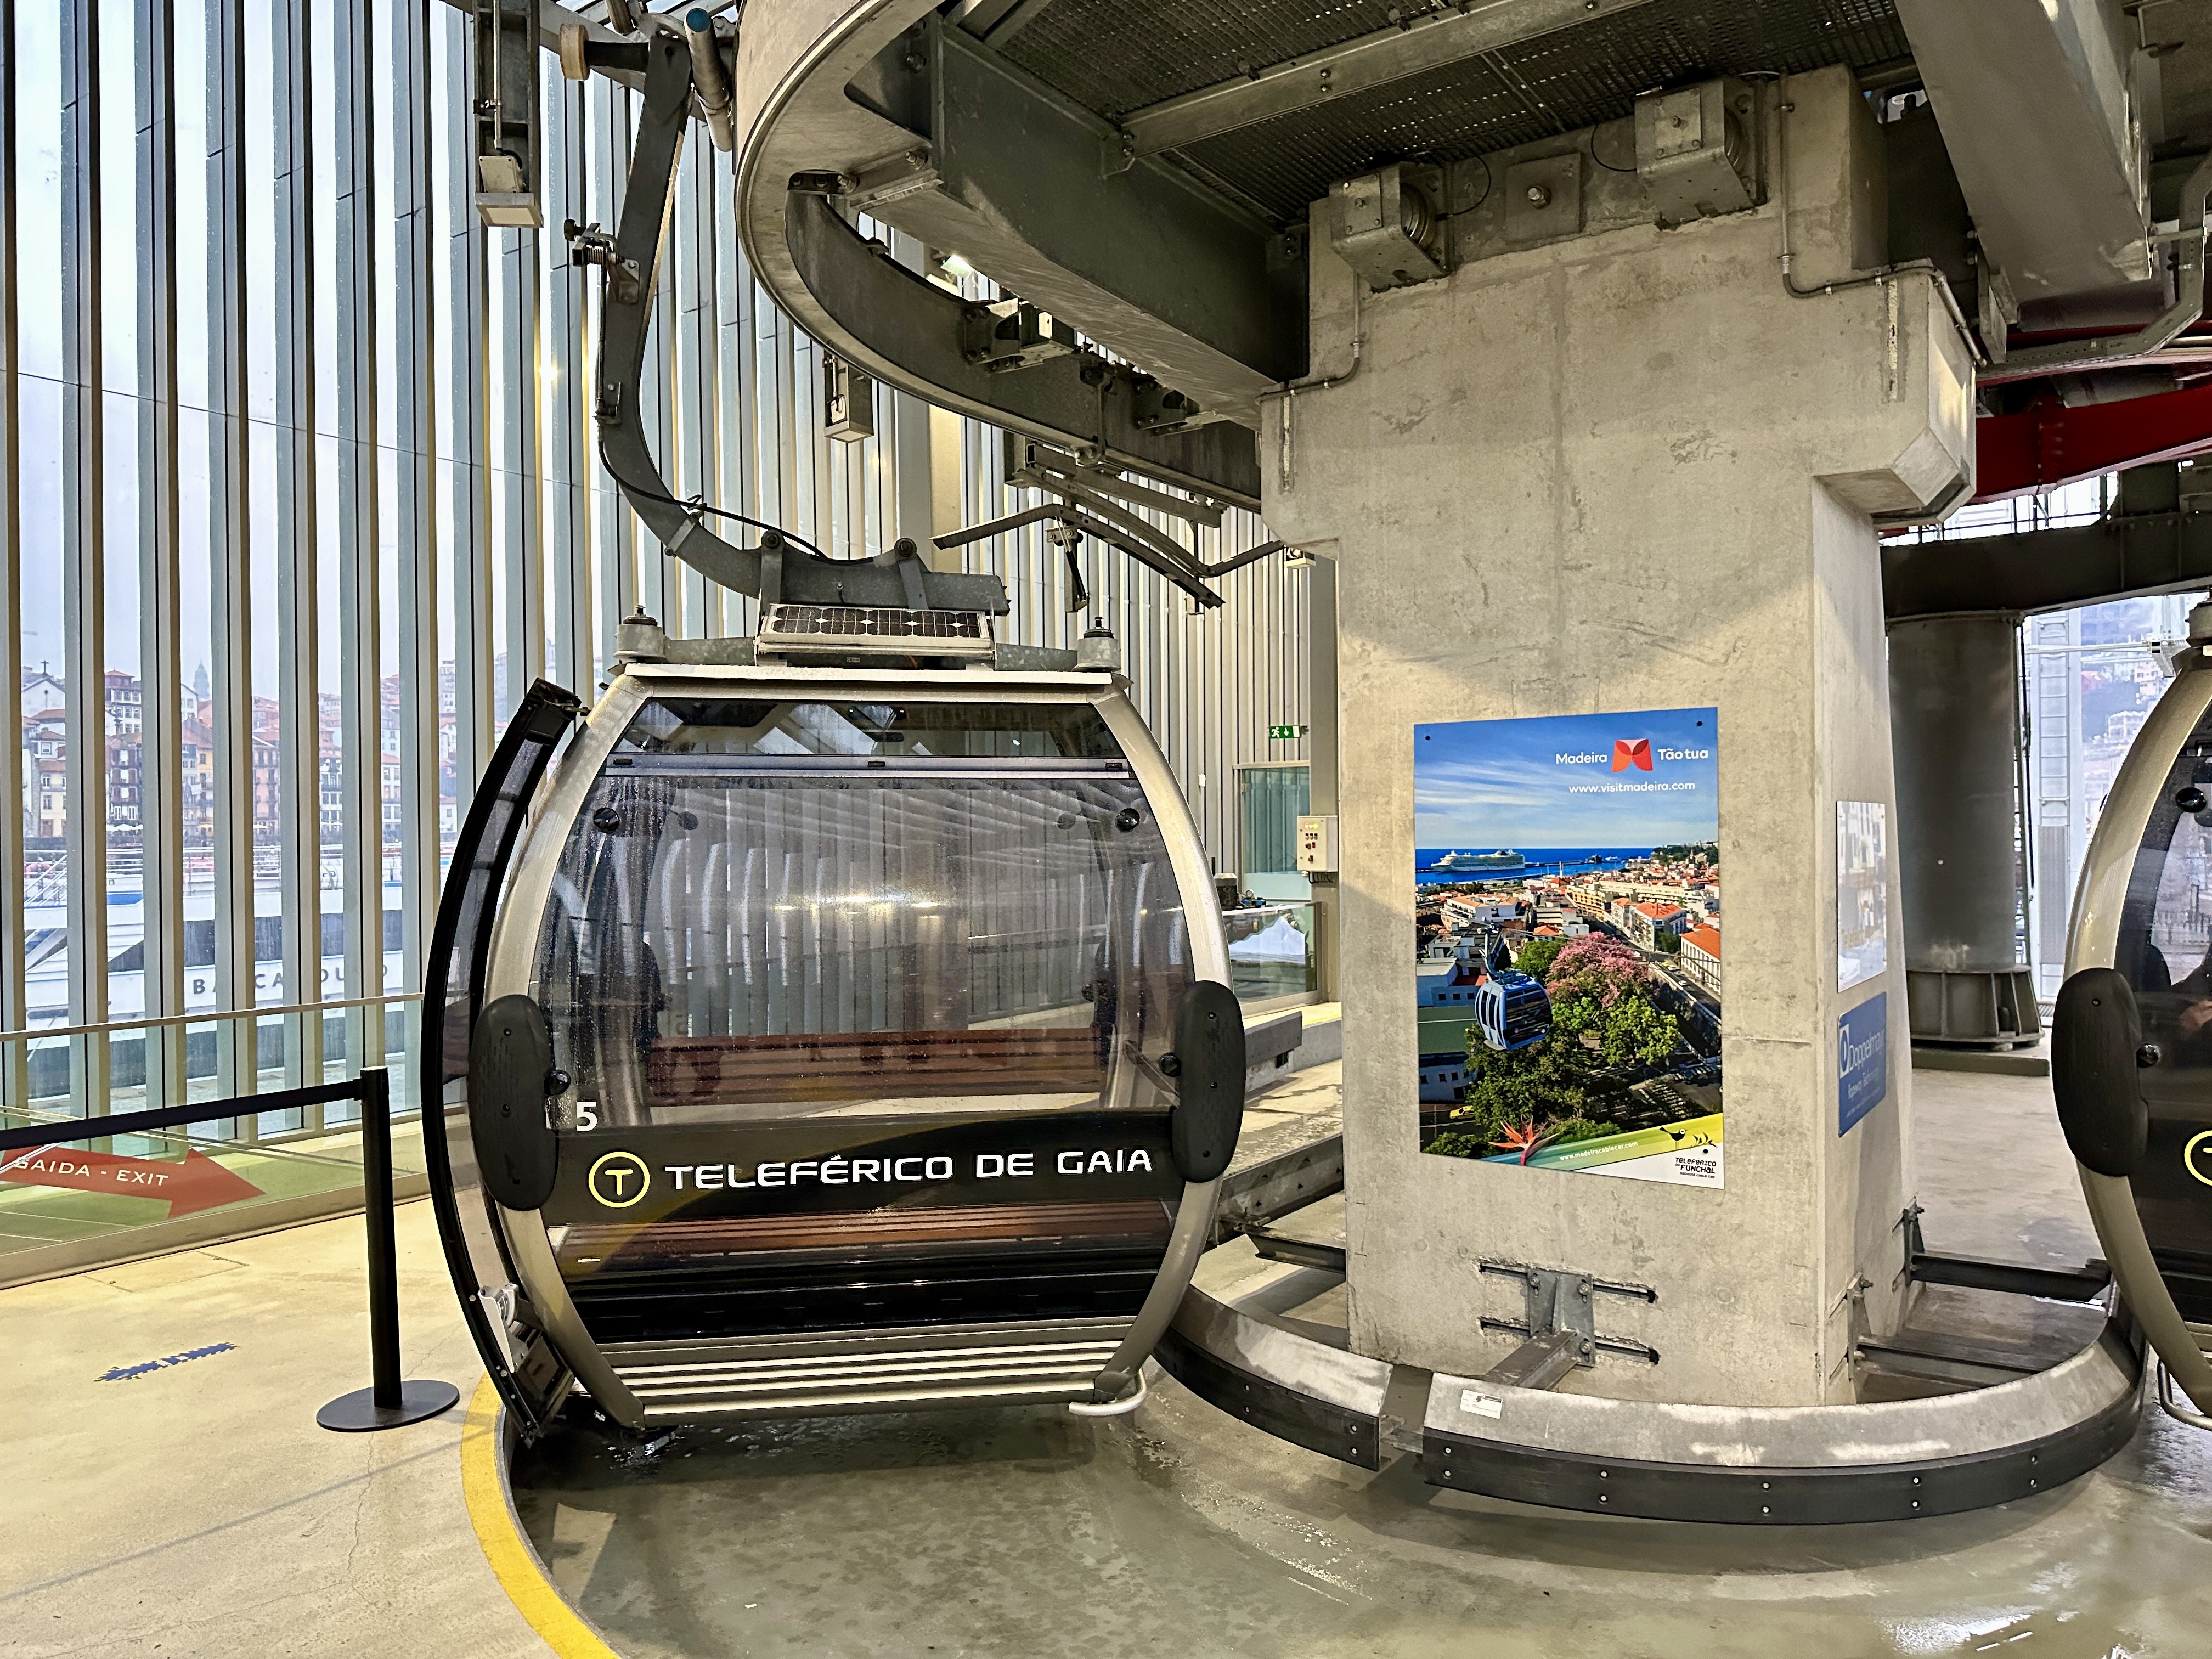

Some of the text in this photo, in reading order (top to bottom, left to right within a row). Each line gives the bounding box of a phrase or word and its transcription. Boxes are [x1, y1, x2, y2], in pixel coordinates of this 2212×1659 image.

[1556, 752, 1607, 764] Madeira
[1657, 748, 1708, 760] Tão tua
[1568, 781, 1695, 793] www.visitmadeira.com
[576, 1101, 598, 1132] 5
[1559, 1141, 1639, 1161] www.madeiracablecar.com
[116, 1169, 169, 1186] EXIT
[663, 1149, 1153, 1190] TELEFÉRICO DE GAIA
